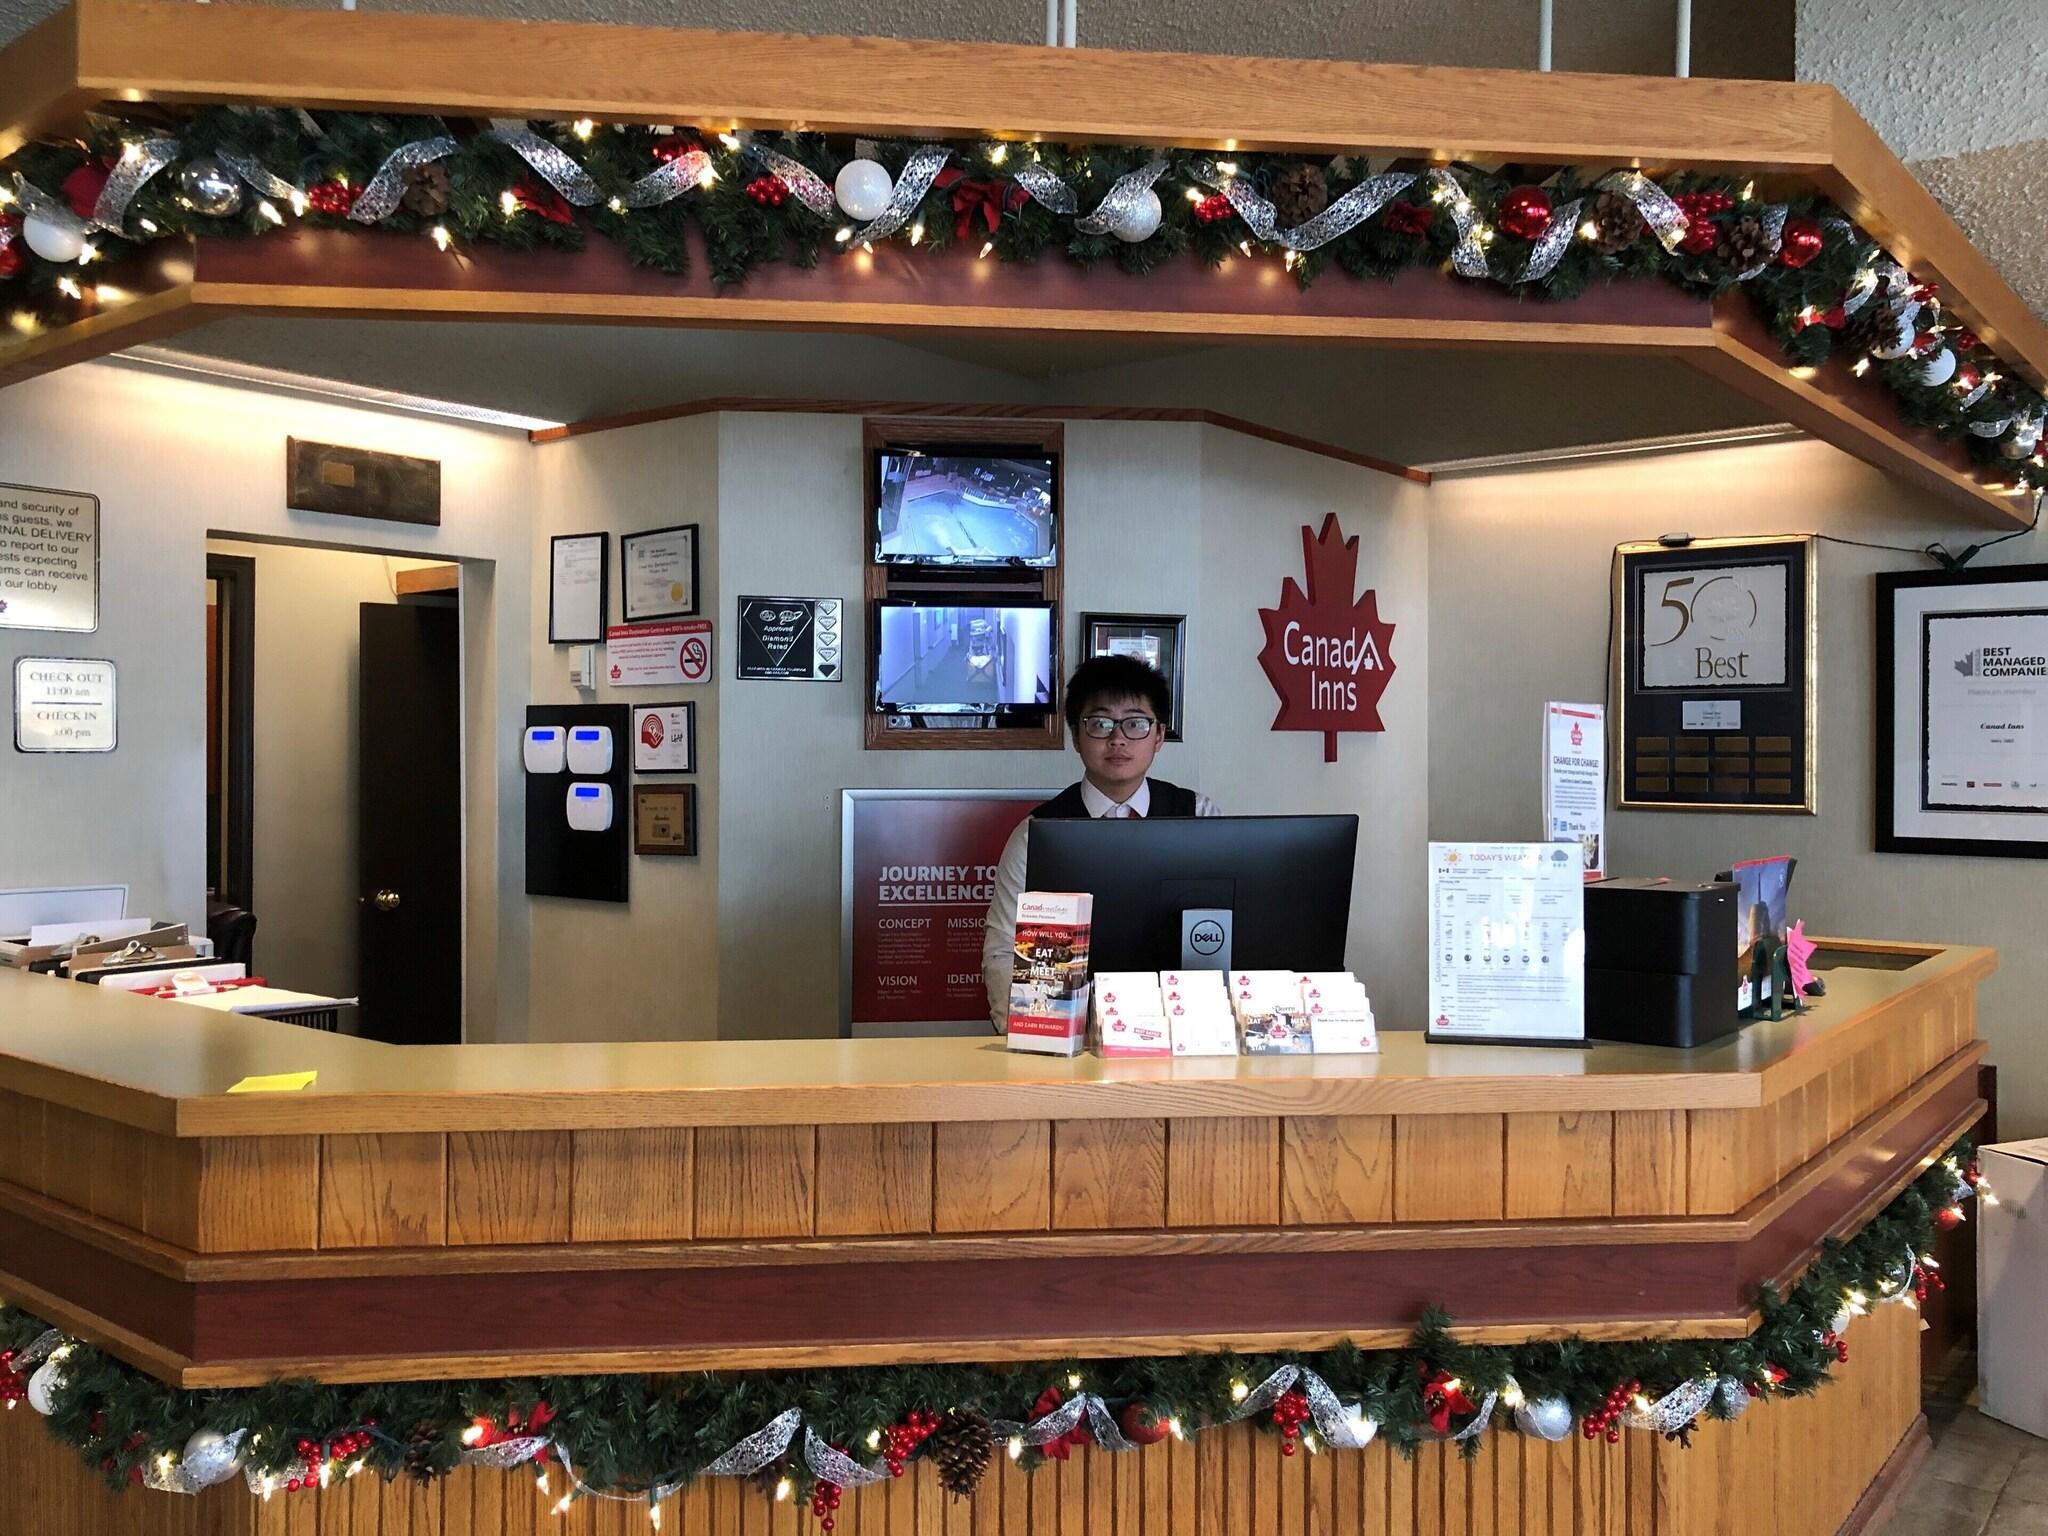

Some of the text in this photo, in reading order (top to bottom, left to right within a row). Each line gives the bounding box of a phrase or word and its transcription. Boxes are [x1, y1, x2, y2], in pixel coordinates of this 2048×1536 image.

[21, 502, 65, 517] security
[68, 507, 79, 516] of
[56, 520, 73, 528] we
[31, 527, 93, 543] DELIVERY
[10, 541, 44, 551] report
[47, 543, 58, 553] to
[61, 546, 79, 554] our
[23, 555, 78, 569] expecting
[24, 567, 45, 577] can
[48, 570, 88, 581] receive
[5, 580, 24, 588] our
[762, 634, 794, 642] Diamond
[1983, 647, 2012, 657] BEST
[1695, 647, 1750, 679] Best
[1983, 656, 2046, 667] MANAGED
[1983, 667, 2048, 677] COMPANIE
[30, 672, 104, 684] CHECK OUT
[1311, 670, 1357, 712] Inns
[37, 711, 97, 721] CHECK IN
[75, 729, 91, 739] pm
[1469, 854, 1503, 862] TODAY'S
[879, 865, 998, 882] JOURNEY TO
[879, 885, 995, 901] EXCELLENCE
[878, 918, 932, 929] CONCEPT
[1039, 930, 1053, 938] WILL
[1194, 933, 1221, 942] DELL
[1035, 948, 1053, 958] EAT
[1030, 966, 1055, 977] MEET
[878, 975, 918, 986] VISION
[1029, 1003, 1052, 1013] PLAY
